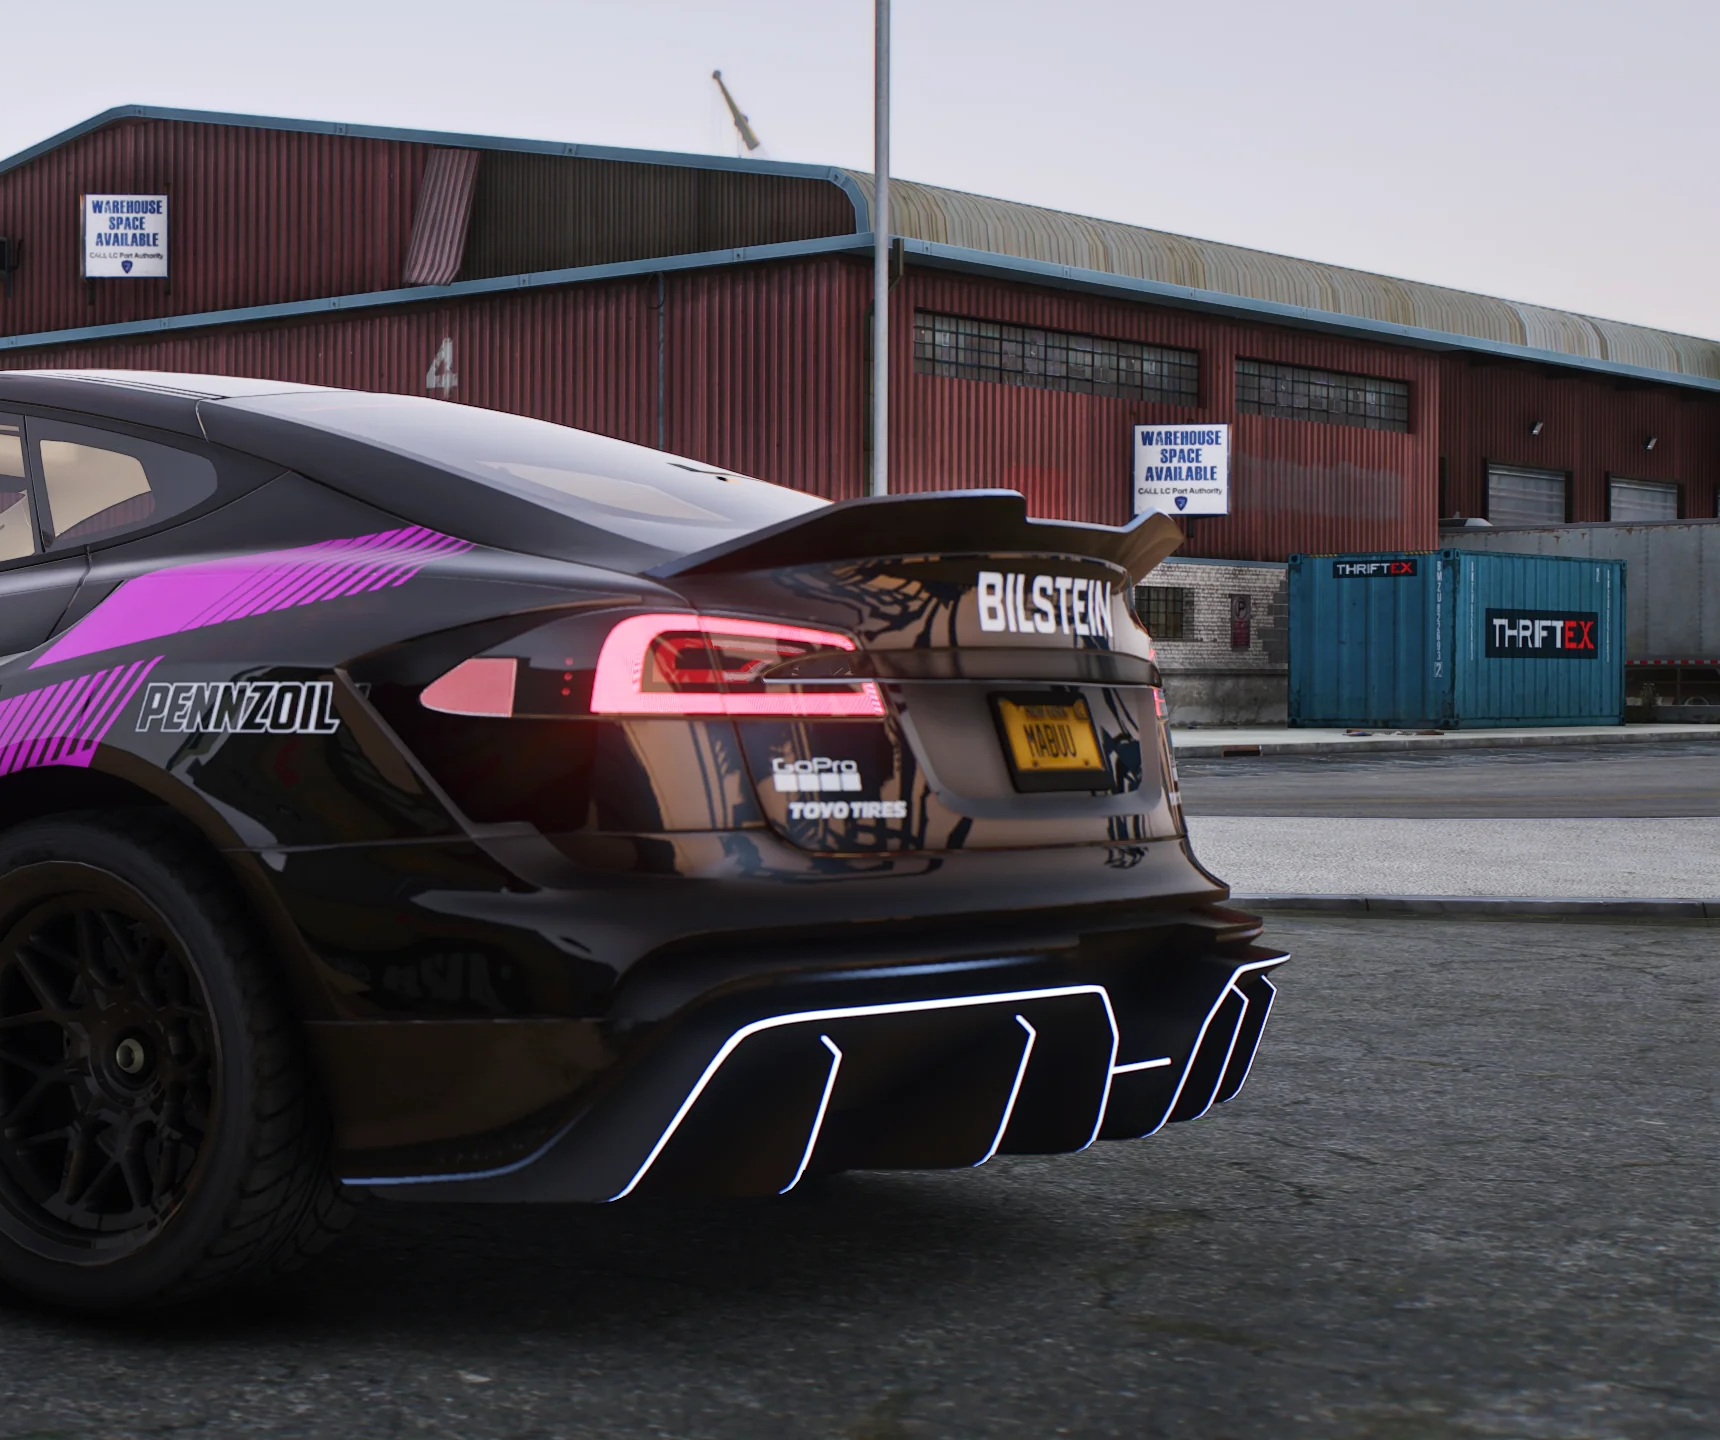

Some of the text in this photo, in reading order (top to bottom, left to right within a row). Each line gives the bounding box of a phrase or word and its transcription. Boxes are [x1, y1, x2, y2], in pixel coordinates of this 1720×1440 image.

[92, 200, 162, 214] WAREHOUSE
[108, 216, 145, 230] SPACE
[96, 233, 159, 246] AVAILABLE
[134, 252, 164, 260] Authority
[426, 337, 458, 399] 4
[1141, 430, 1222, 446] WAREHOUSE
[1160, 449, 1202, 463] SPACE
[1145, 466, 1217, 481] AVAILABLE
[1189, 488, 1222, 496] Authority
[1337, 562, 1413, 575] THRIFTEX
[978, 571, 1113, 638] BILSTEIN
[1493, 618, 1595, 650] THRIFTEX
[135, 681, 341, 734] PENNZOIL
[1023, 723, 1077, 759] MABUU
[772, 757, 858, 774] GoPro
[789, 800, 908, 820] TOYO TIRES
